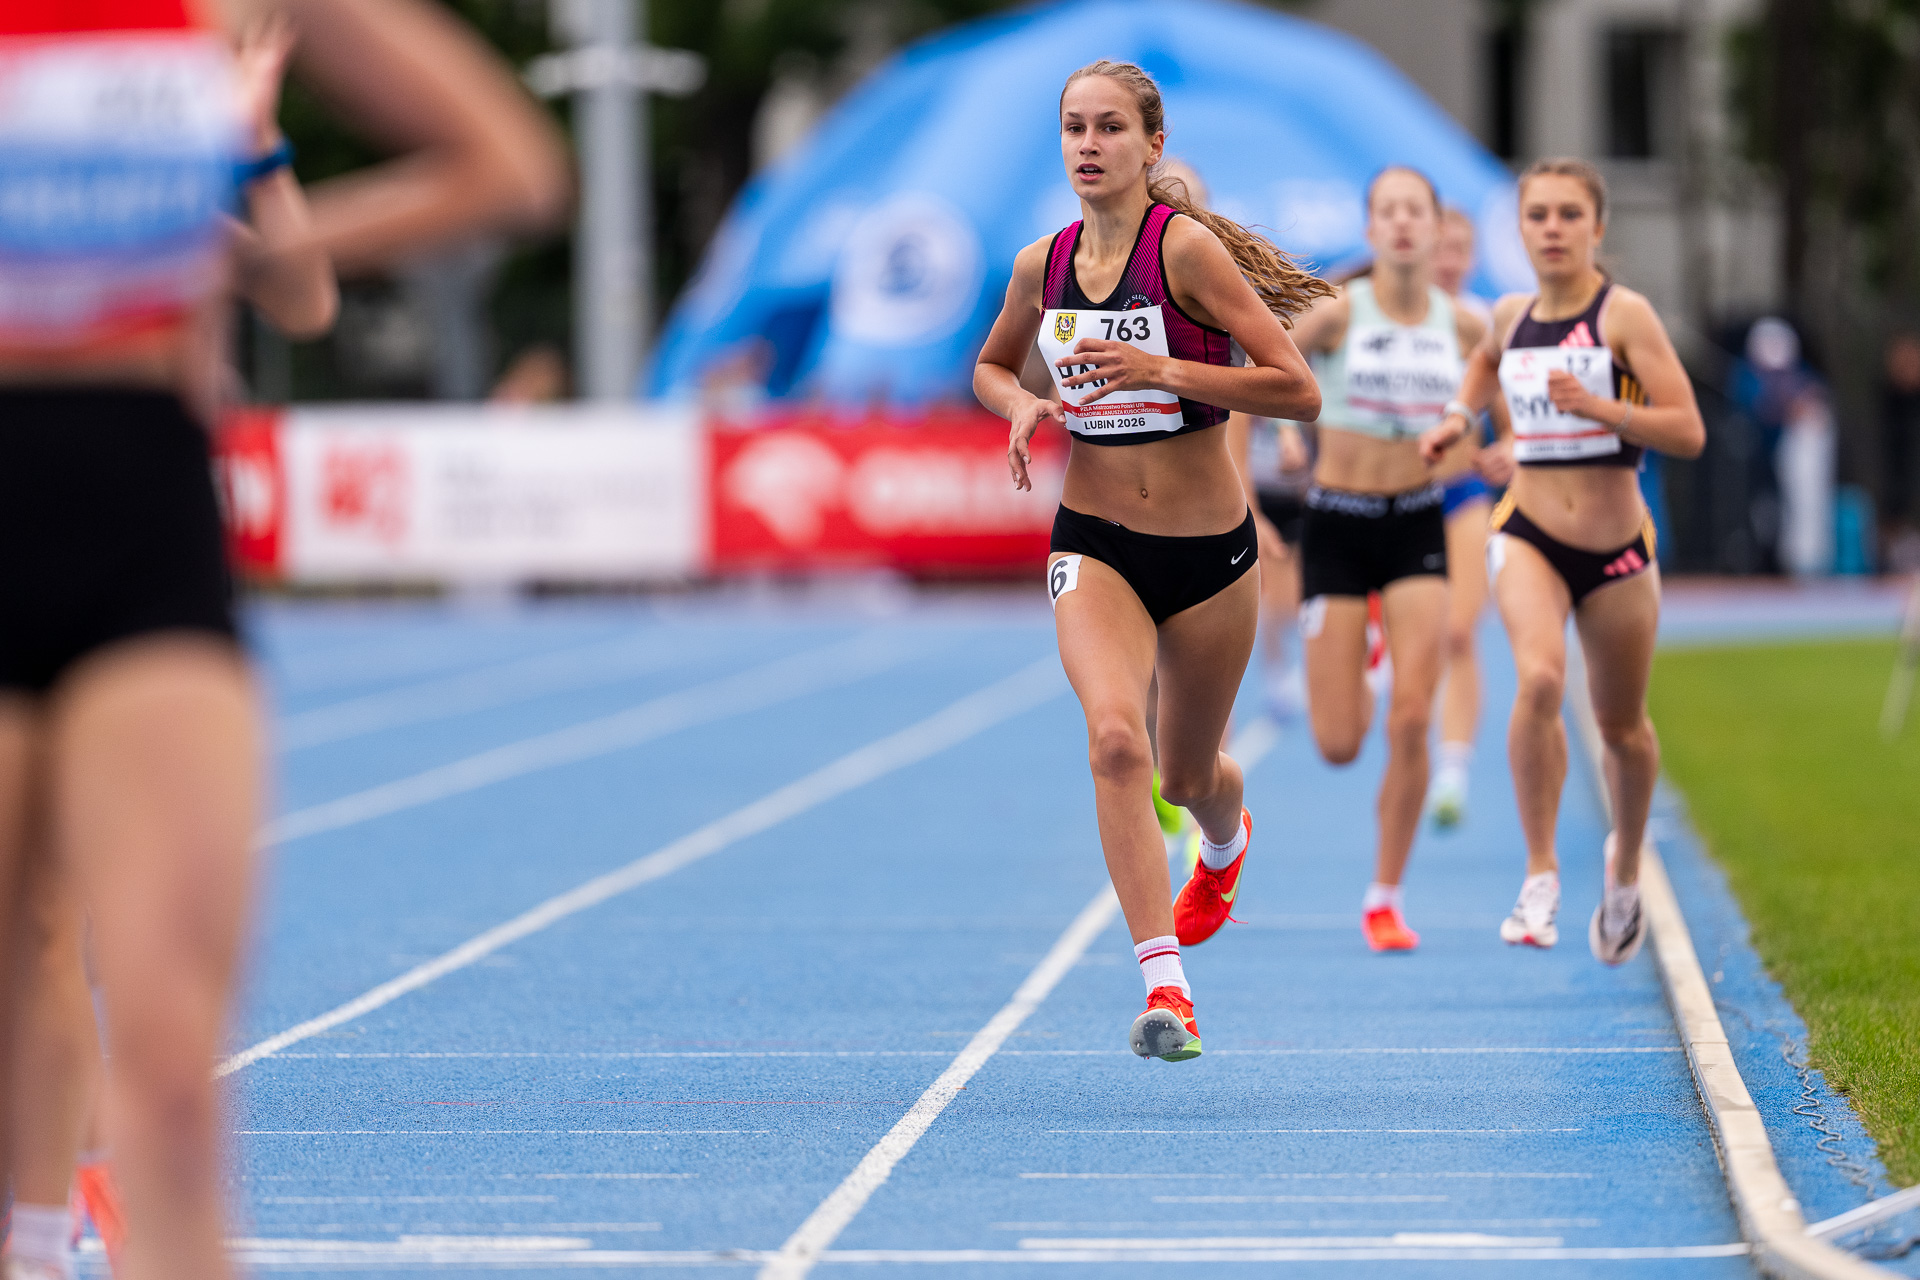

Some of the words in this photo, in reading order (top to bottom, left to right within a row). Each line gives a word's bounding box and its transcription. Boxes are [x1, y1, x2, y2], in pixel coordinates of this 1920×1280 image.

[1100, 316, 1150, 342] 763
[1084, 419, 1115, 430] LUBIN
[1117, 417, 1146, 428] 2026
[1050, 560, 1068, 599] 6
